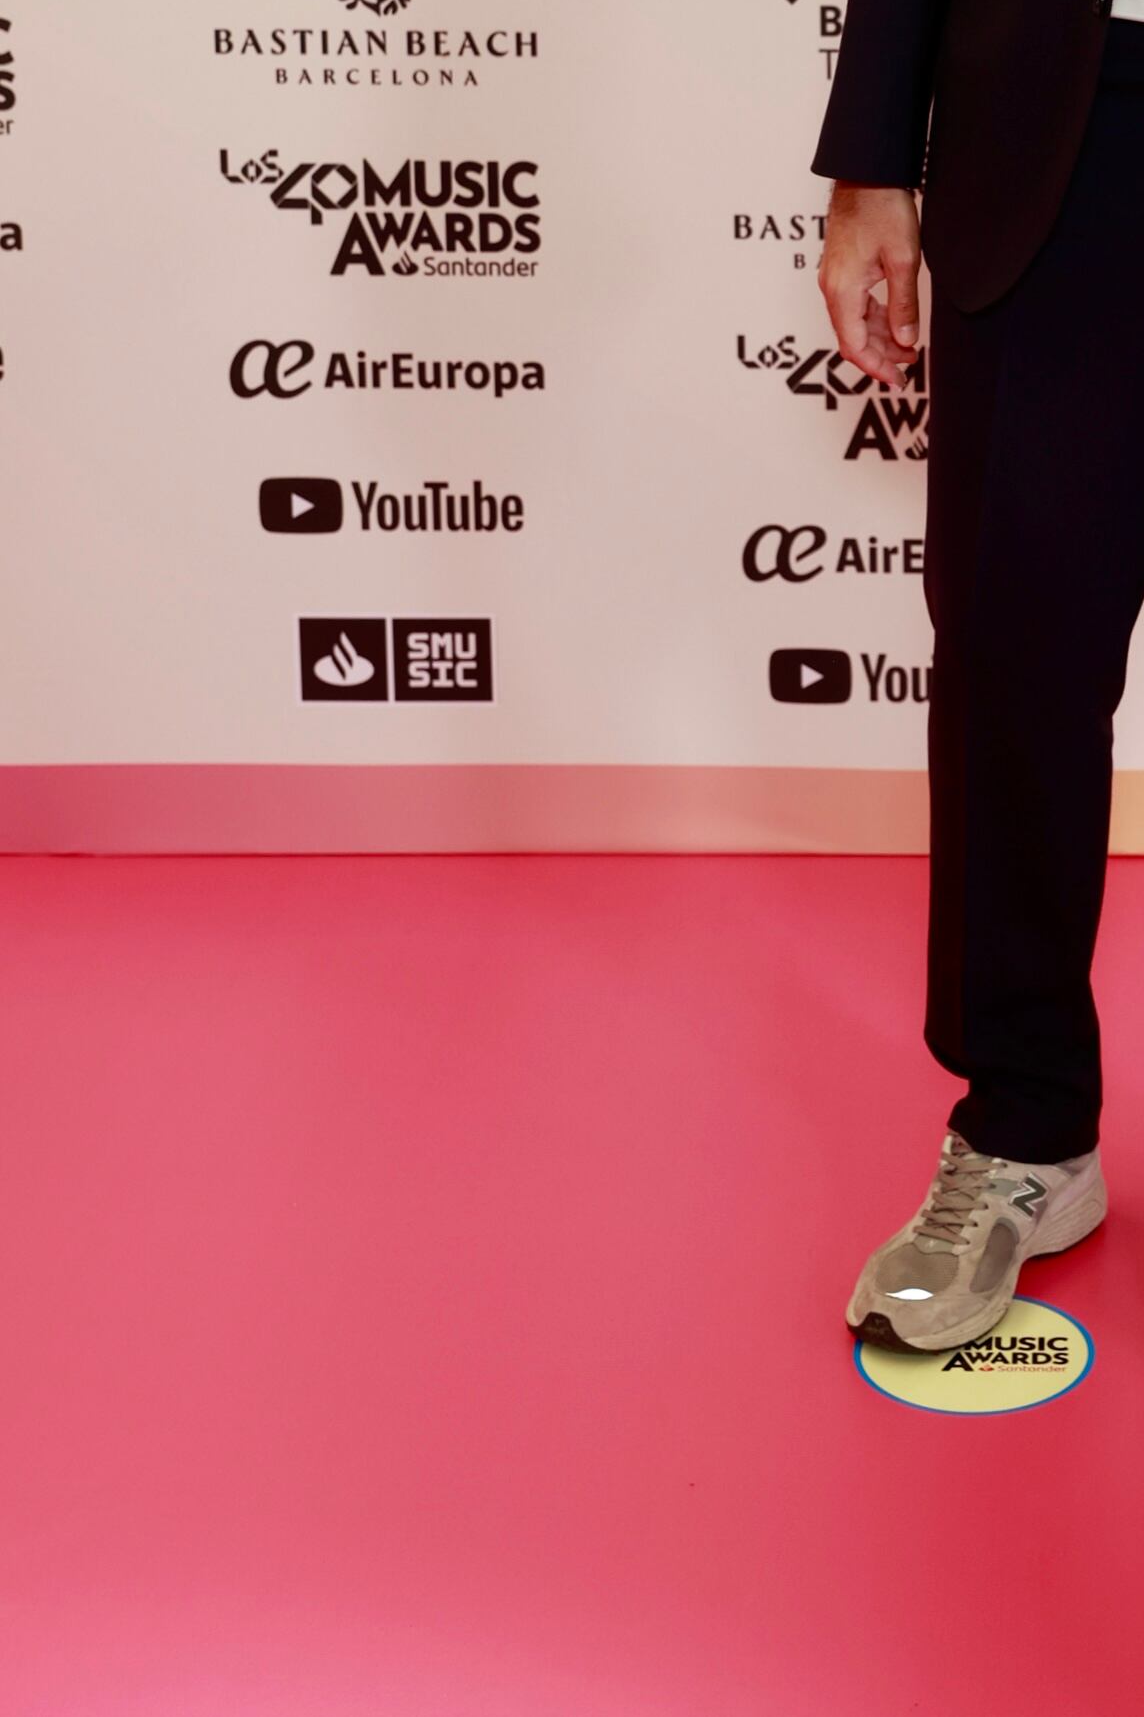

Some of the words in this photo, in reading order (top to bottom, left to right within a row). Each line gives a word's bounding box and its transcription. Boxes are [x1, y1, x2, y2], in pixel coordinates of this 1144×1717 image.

[214, 29, 387, 56] BASTIAN
[406, 30, 538, 57] BEACH
[275, 68, 478, 86] BARCELONA
[362, 158, 540, 209] MUSIC
[328, 209, 545, 277] AWARDS
[423, 256, 539, 277] Santander
[324, 350, 545, 399] AirEuropa
[351, 480, 524, 532] YouTube
[965, 1336, 1069, 1352] MUSIC
[941, 1351, 1069, 1372] AWARDS
